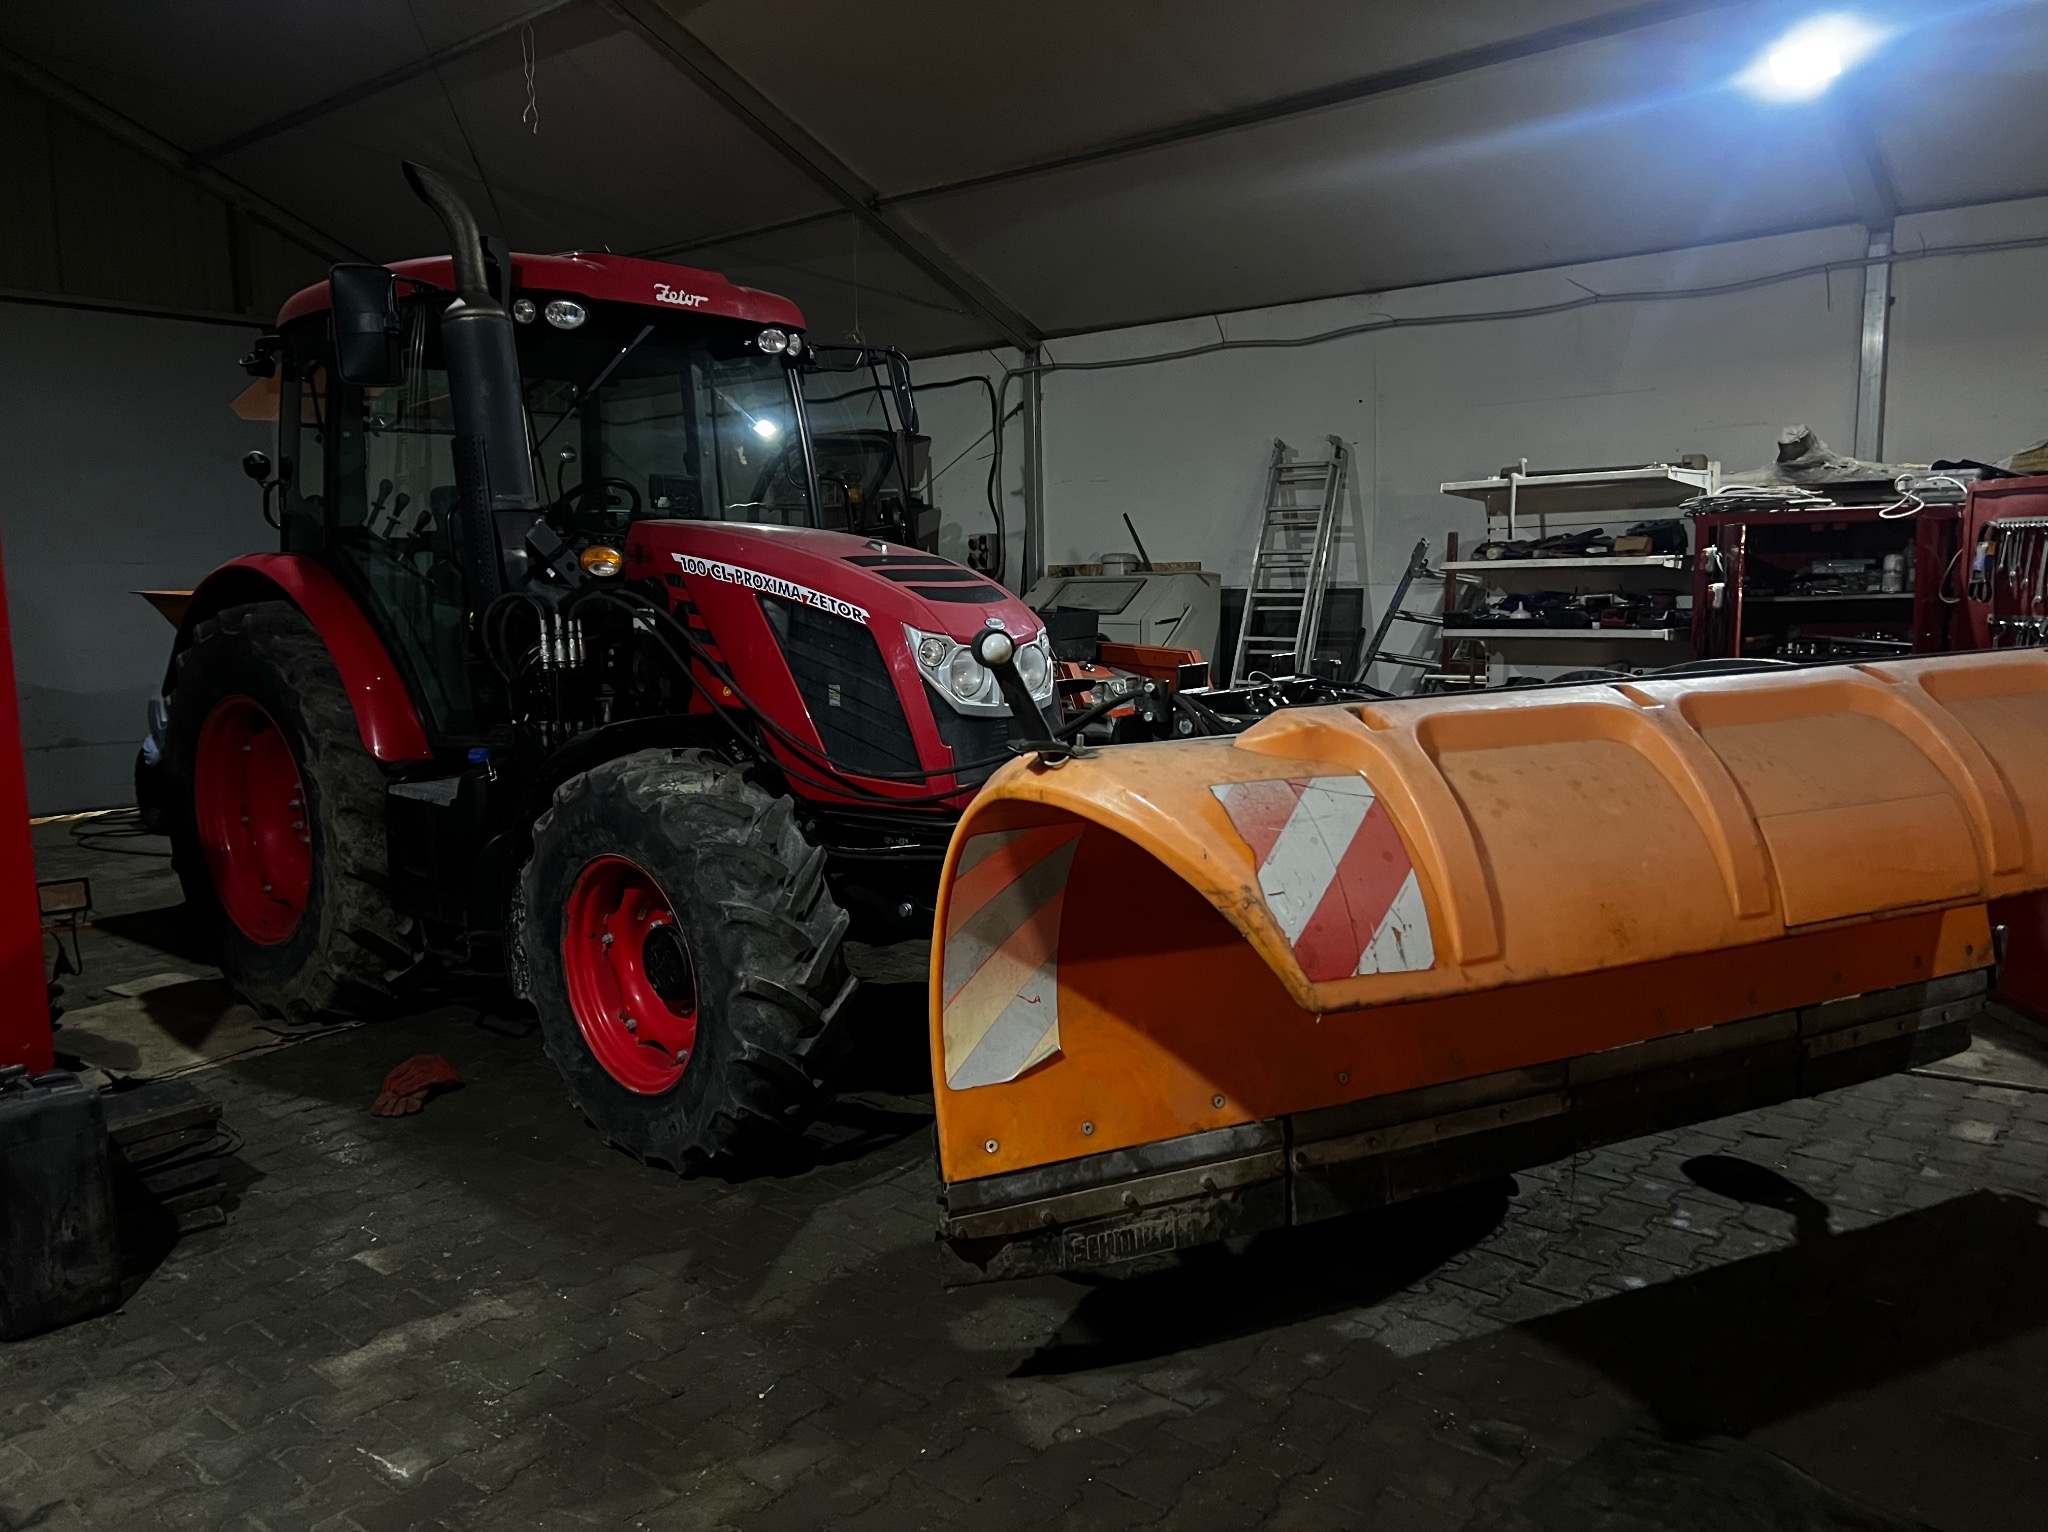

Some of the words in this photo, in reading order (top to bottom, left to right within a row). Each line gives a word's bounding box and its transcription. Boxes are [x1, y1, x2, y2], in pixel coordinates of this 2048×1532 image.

[653, 283, 709, 307] Zetor
[680, 556, 707, 576] 100
[711, 563, 732, 582] CL
[734, 568, 802, 600] PROXIMA
[807, 590, 865, 623] ZETOR
